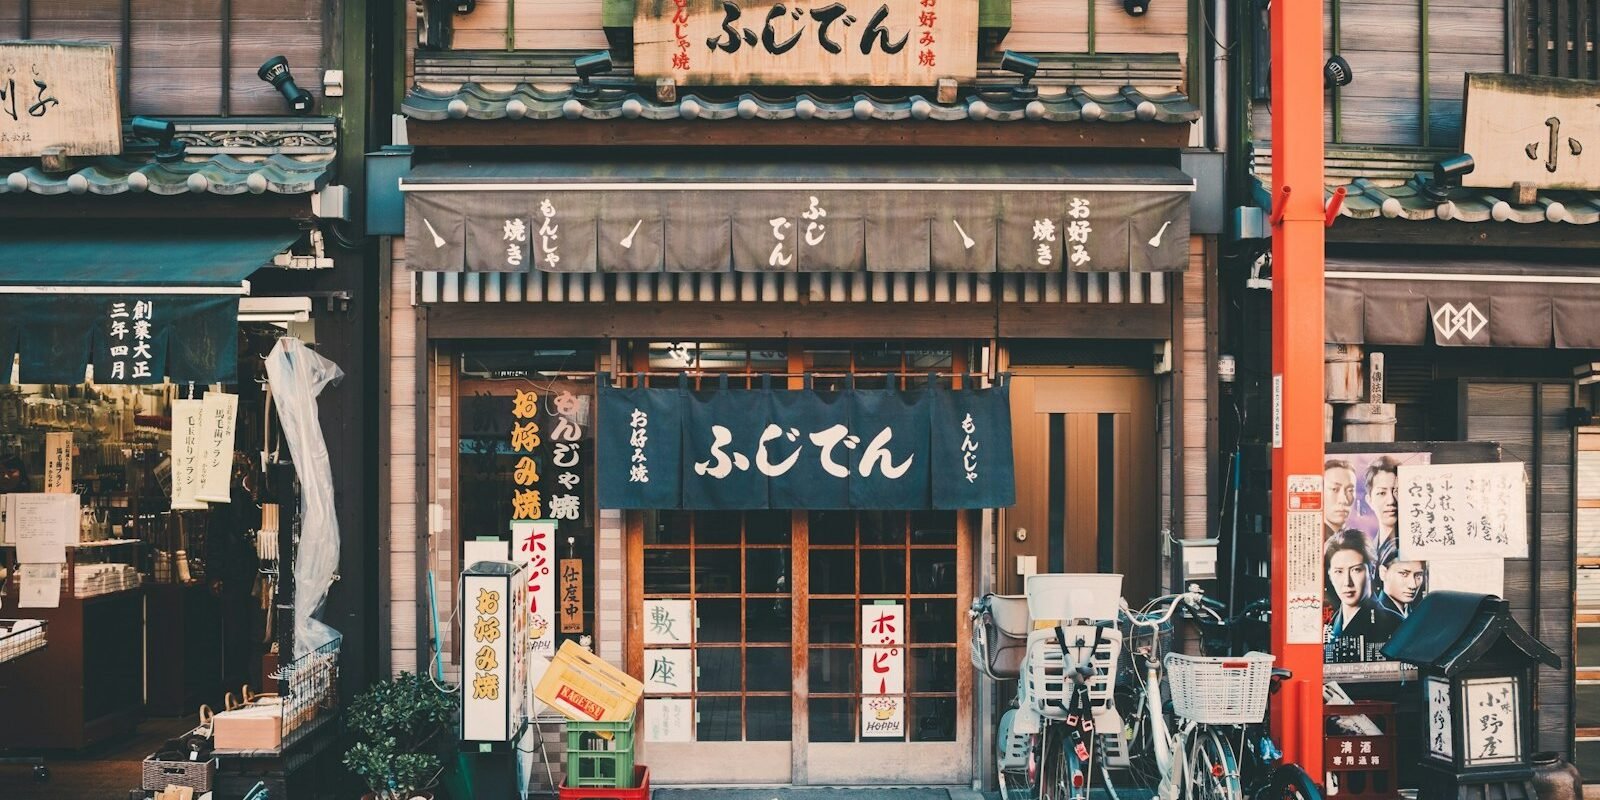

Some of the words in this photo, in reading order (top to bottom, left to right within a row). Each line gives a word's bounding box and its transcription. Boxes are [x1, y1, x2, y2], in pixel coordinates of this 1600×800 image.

[706, 1, 911, 55] ふじでん
[503, 218, 526, 266] 焼き
[539, 198, 560, 268] もんじゃ
[769, 217, 793, 267] でん
[802, 196, 827, 246] ふじ
[1032, 218, 1056, 266] 焼き
[1067, 197, 1092, 266] お好み
[110, 302, 130, 380] 三年四月
[132, 300, 153, 378] 創業大正
[511, 388, 542, 520] お好み焼
[549, 390, 582, 520] もんじゃ焼
[629, 408, 649, 483] お好み焼
[694, 423, 914, 480] ふじでん
[961, 412, 979, 484] もんじゃ
[522, 527, 549, 613] ホッピー
[563, 565, 580, 621] 仕度中
[473, 587, 500, 701] お好み焼
[871, 609, 898, 696] ホッピー
[560, 685, 605, 717] KAGETSU
[1478, 691, 1504, 758] 小野屋
[1340, 741, 1372, 754] 清酒
